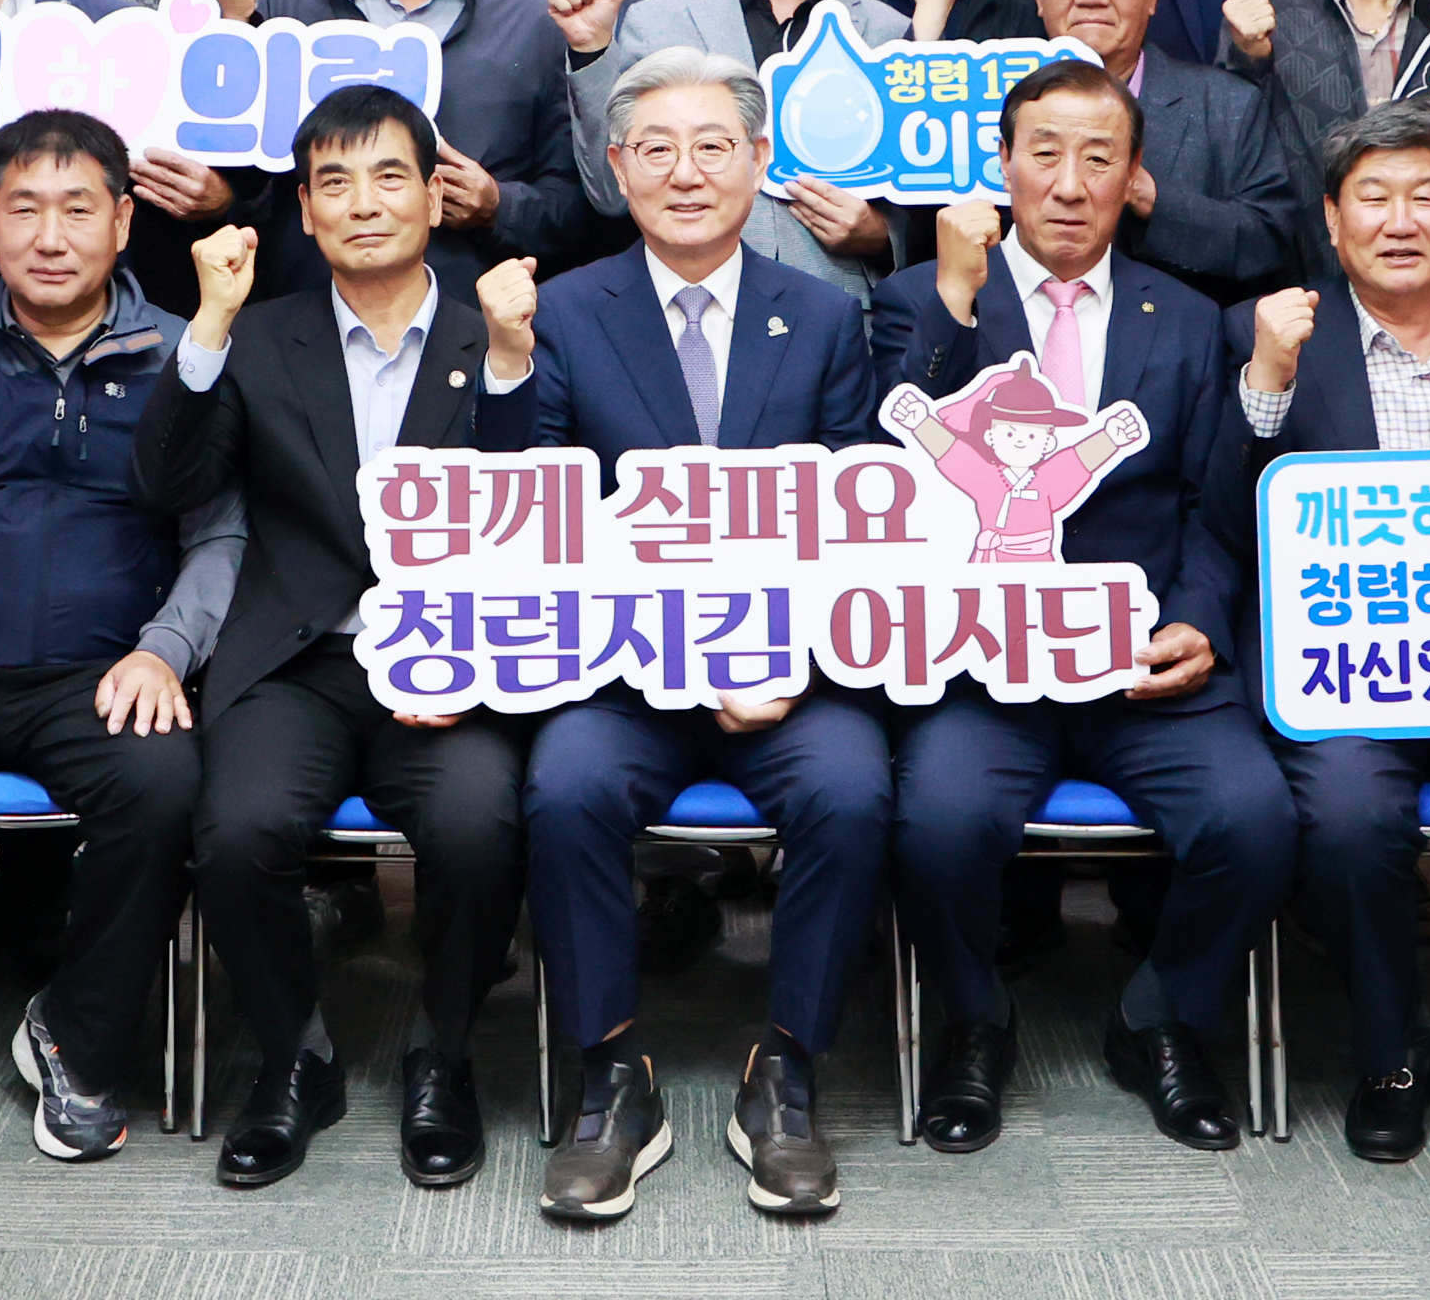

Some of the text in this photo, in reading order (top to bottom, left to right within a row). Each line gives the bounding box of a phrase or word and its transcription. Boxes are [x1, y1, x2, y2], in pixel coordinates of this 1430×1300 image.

[884, 57, 969, 103] 청렴
[375, 460, 928, 567] 함께 살펴요
[373, 581, 1142, 696] 청렴지킴 어사단
